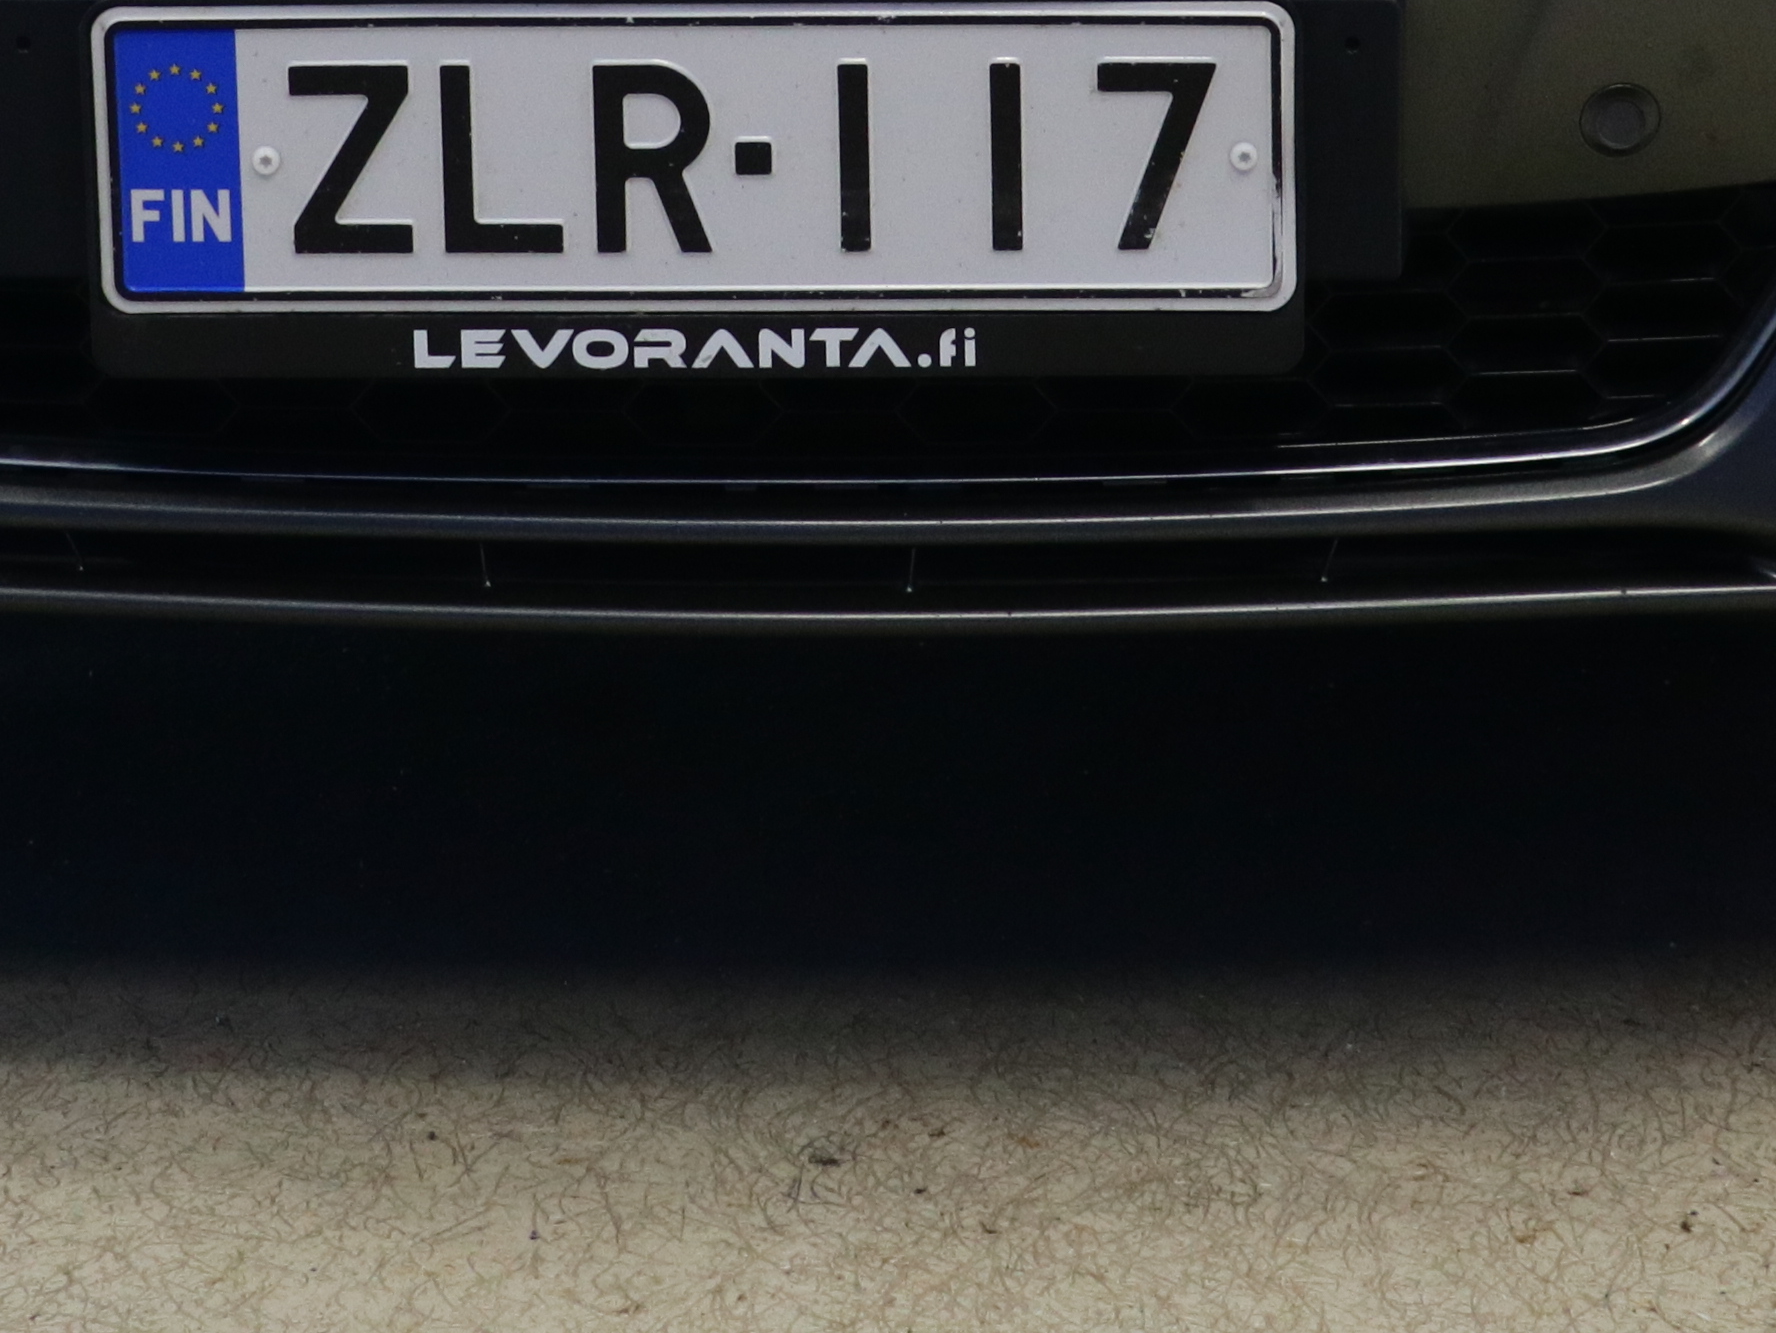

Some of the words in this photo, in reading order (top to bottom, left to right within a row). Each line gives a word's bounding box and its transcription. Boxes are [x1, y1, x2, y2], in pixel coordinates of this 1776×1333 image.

[286, 60, 1217, 254] ZLR-117
[129, 188, 232, 243] FIN
[414, 327, 979, 370] LEVORANTA.fi
